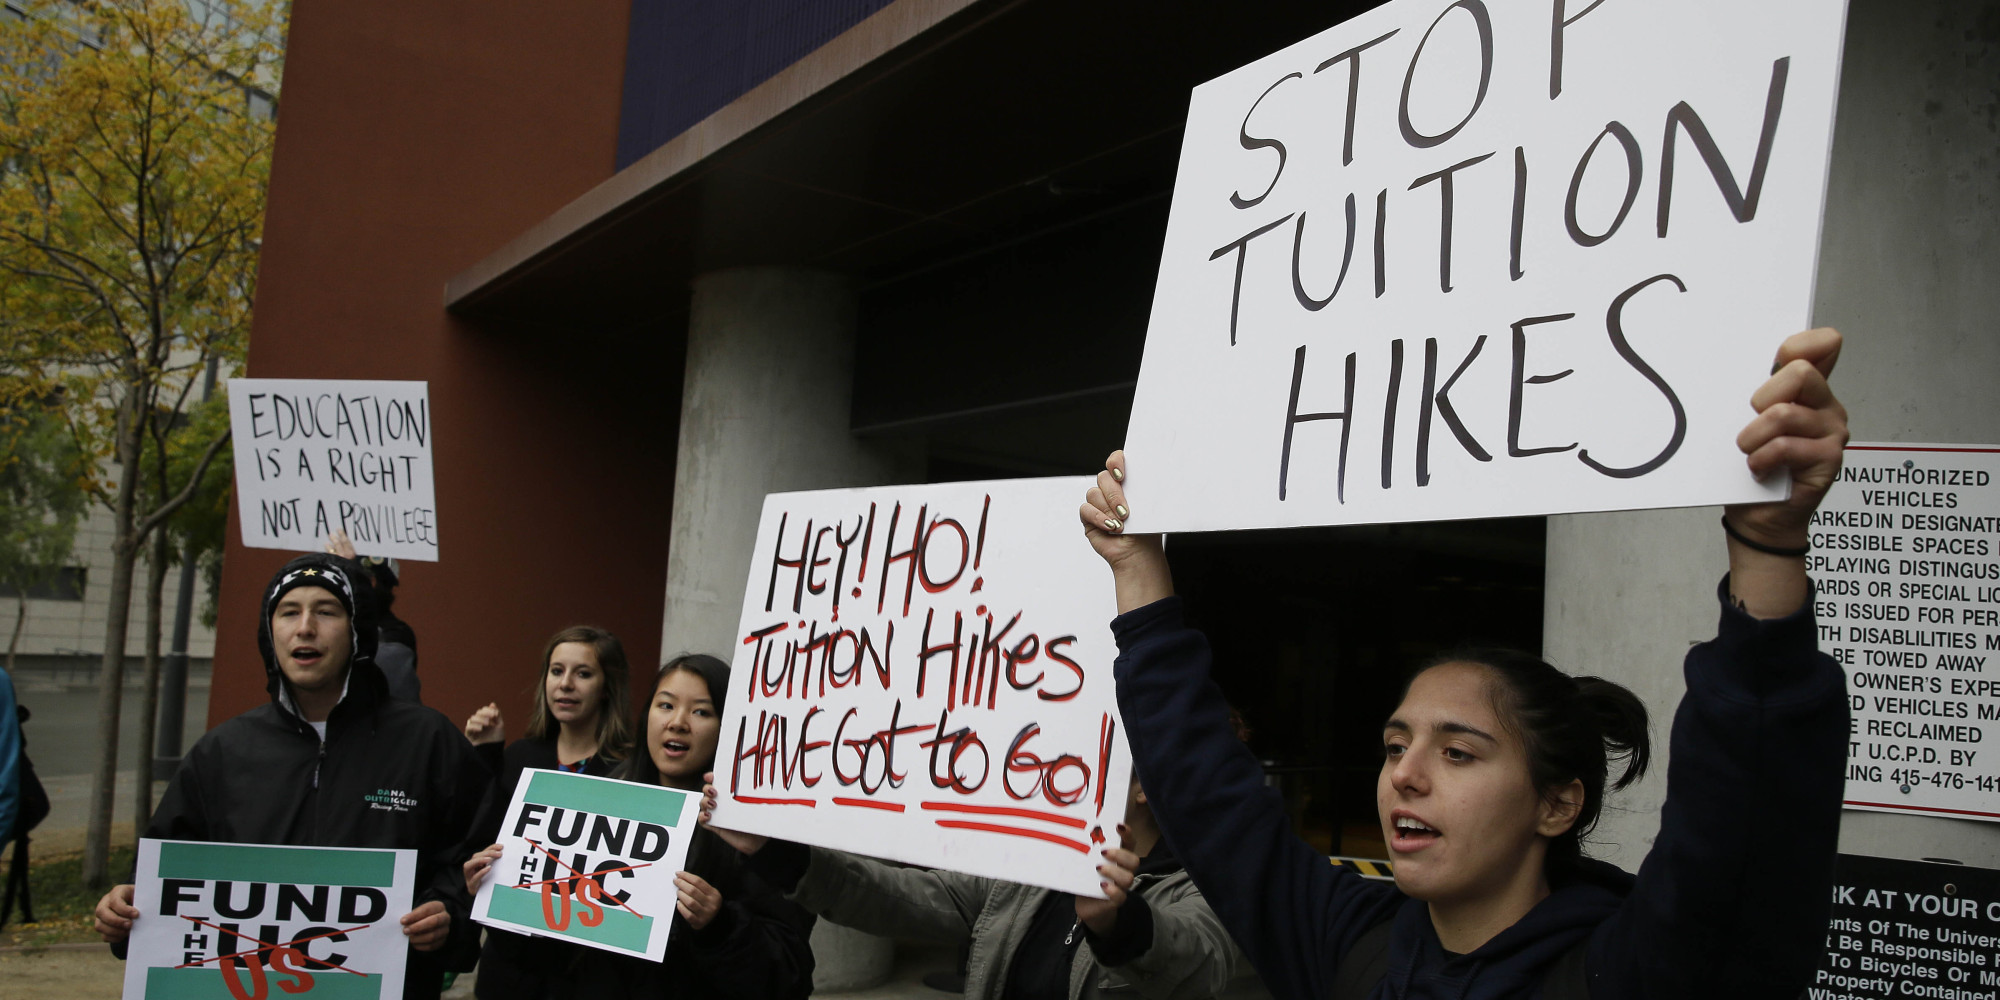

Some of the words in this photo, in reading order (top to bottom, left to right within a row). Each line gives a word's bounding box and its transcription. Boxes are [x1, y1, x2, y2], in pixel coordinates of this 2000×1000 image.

[1229, 0, 1602, 210] STOP
[1208, 56, 1791, 346] TUITION
[1279, 273, 1687, 504] HIKES
[248, 393, 426, 448] EDUCATION
[256, 448, 281, 481] IS
[299, 448, 314, 482] A
[328, 448, 418, 494] RIGHT
[1862, 490, 1958, 509] VEHICLES
[261, 498, 301, 538] NOT
[315, 499, 330, 538] A
[339, 500, 437, 546] PRIVILEGE
[1809, 510, 1872, 528] ARKED
[877, 493, 991, 618] HO!
[1807, 532, 1903, 552] CESSIBLE
[1912, 537, 1989, 556] SPACES
[1805, 555, 1890, 574] SPLAYING
[1900, 560, 2000, 580] DISTINGUS
[1815, 579, 1860, 596] ARDS
[1868, 581, 1891, 598] OR
[1899, 583, 1970, 602] SPECIAL
[1815, 602, 1837, 618] ES
[1845, 603, 1909, 622] ISSUED
[1918, 607, 1954, 624] FOR
[1963, 609, 2000, 627] PER
[1818, 625, 1841, 641] TH
[1850, 627, 1977, 649] DISABLILITIES
[1833, 648, 1855, 665] BE
[1863, 650, 1927, 669] TOWED
[1936, 654, 1986, 672] AWAY
[1853, 672, 1942, 694] OWNER'S
[1951, 678, 2000, 698] EXPE
[1874, 696, 1968, 719] VEHICLES
[1867, 719, 1982, 743] RECLAIMED
[730, 705, 831, 795] HAVE
[1869, 743, 1941, 765] U.C.P.D.
[1950, 749, 1976, 767] BY
[512, 802, 670, 862] FUND
[518, 840, 542, 889] THE
[159, 878, 388, 924] FUND
[541, 878, 604, 932] US
[1862, 888, 1897, 909] AT
[1904, 892, 1978, 920] YOUR
[183, 916, 209, 967] THE
[1829, 917, 1862, 932] nts
[1868, 919, 1890, 936] Of
[1895, 922, 1930, 940] The
[1839, 935, 1863, 951] Be
[1871, 938, 1986, 966] Responsible
[219, 947, 315, 1000] US
[1828, 952, 1851, 969] To
[1860, 956, 1938, 979] Bicycles
[1948, 967, 1970, 983] Or
[1815, 969, 1894, 996] Property
[1900, 980, 1996, 1000] Contained
